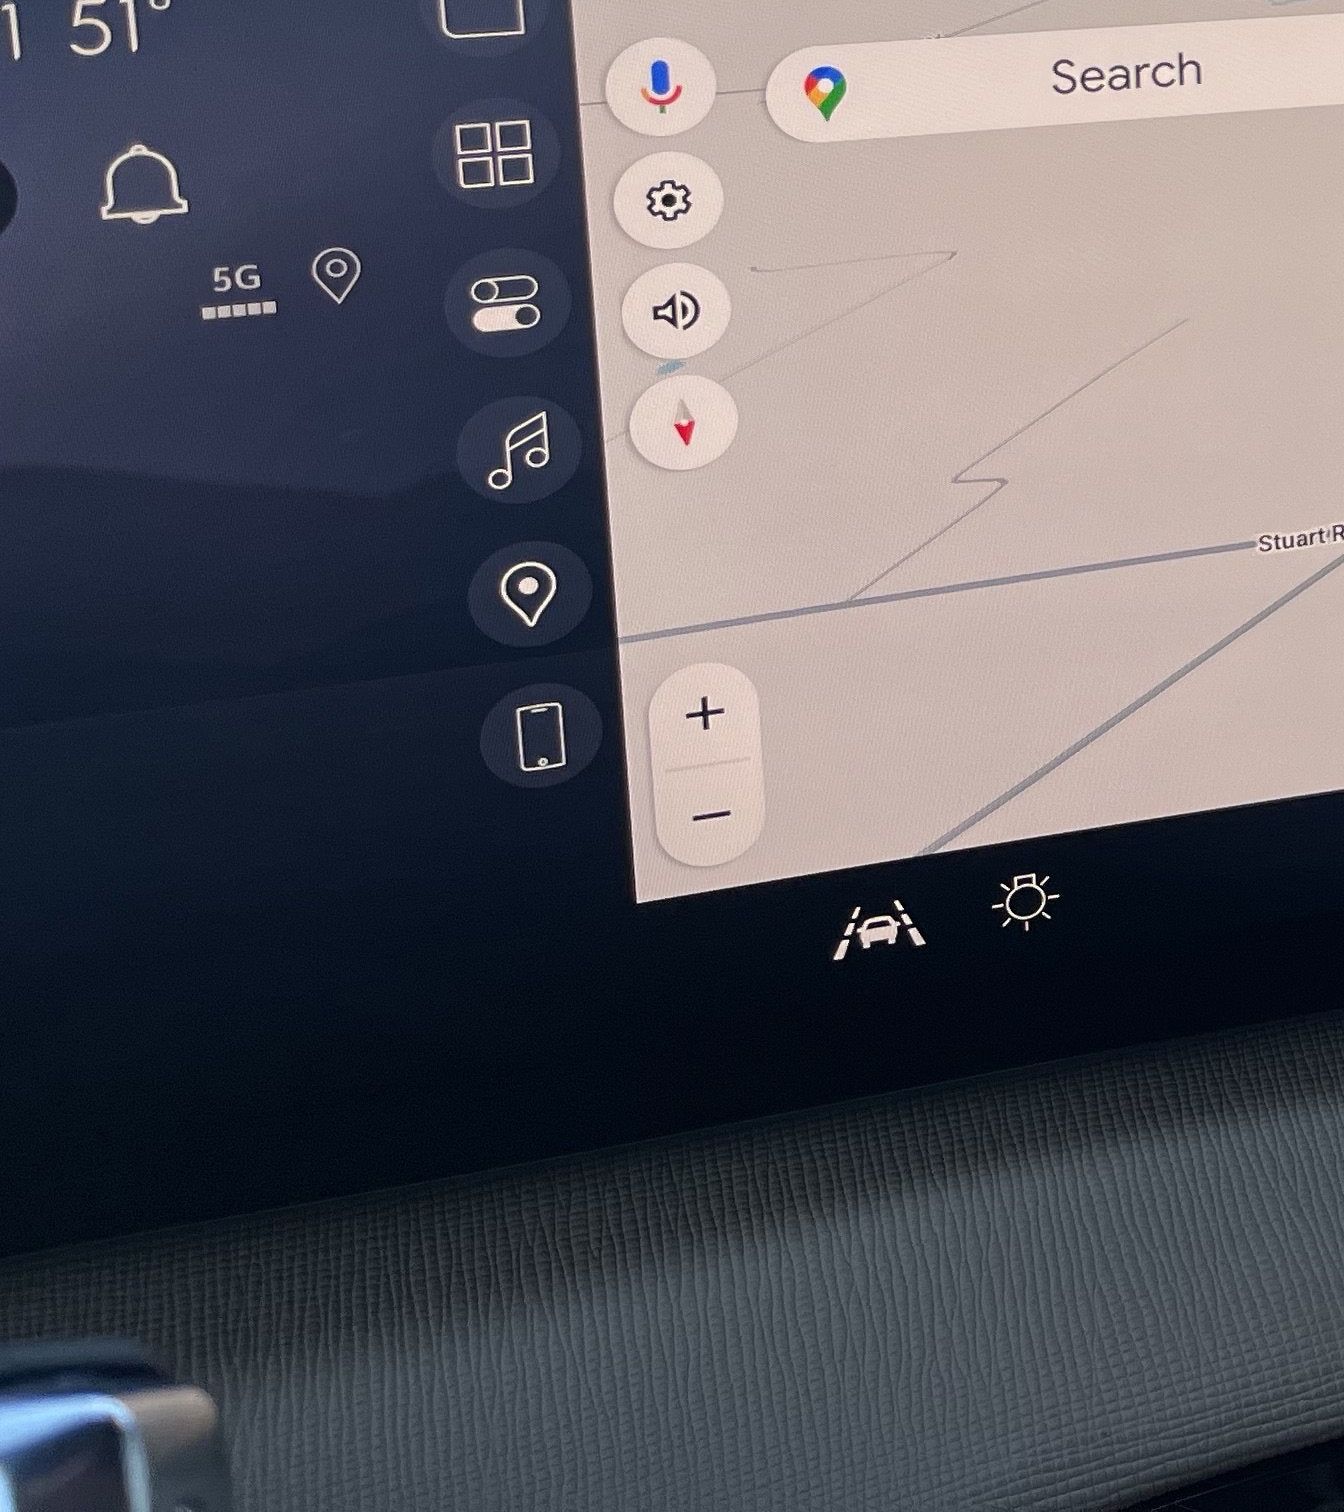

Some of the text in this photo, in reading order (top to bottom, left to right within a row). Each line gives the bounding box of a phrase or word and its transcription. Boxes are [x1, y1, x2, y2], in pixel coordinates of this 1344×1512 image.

[1052, 51, 1203, 95] Search
[213, 264, 261, 292] 5G
[1258, 527, 1327, 552] Stuart
